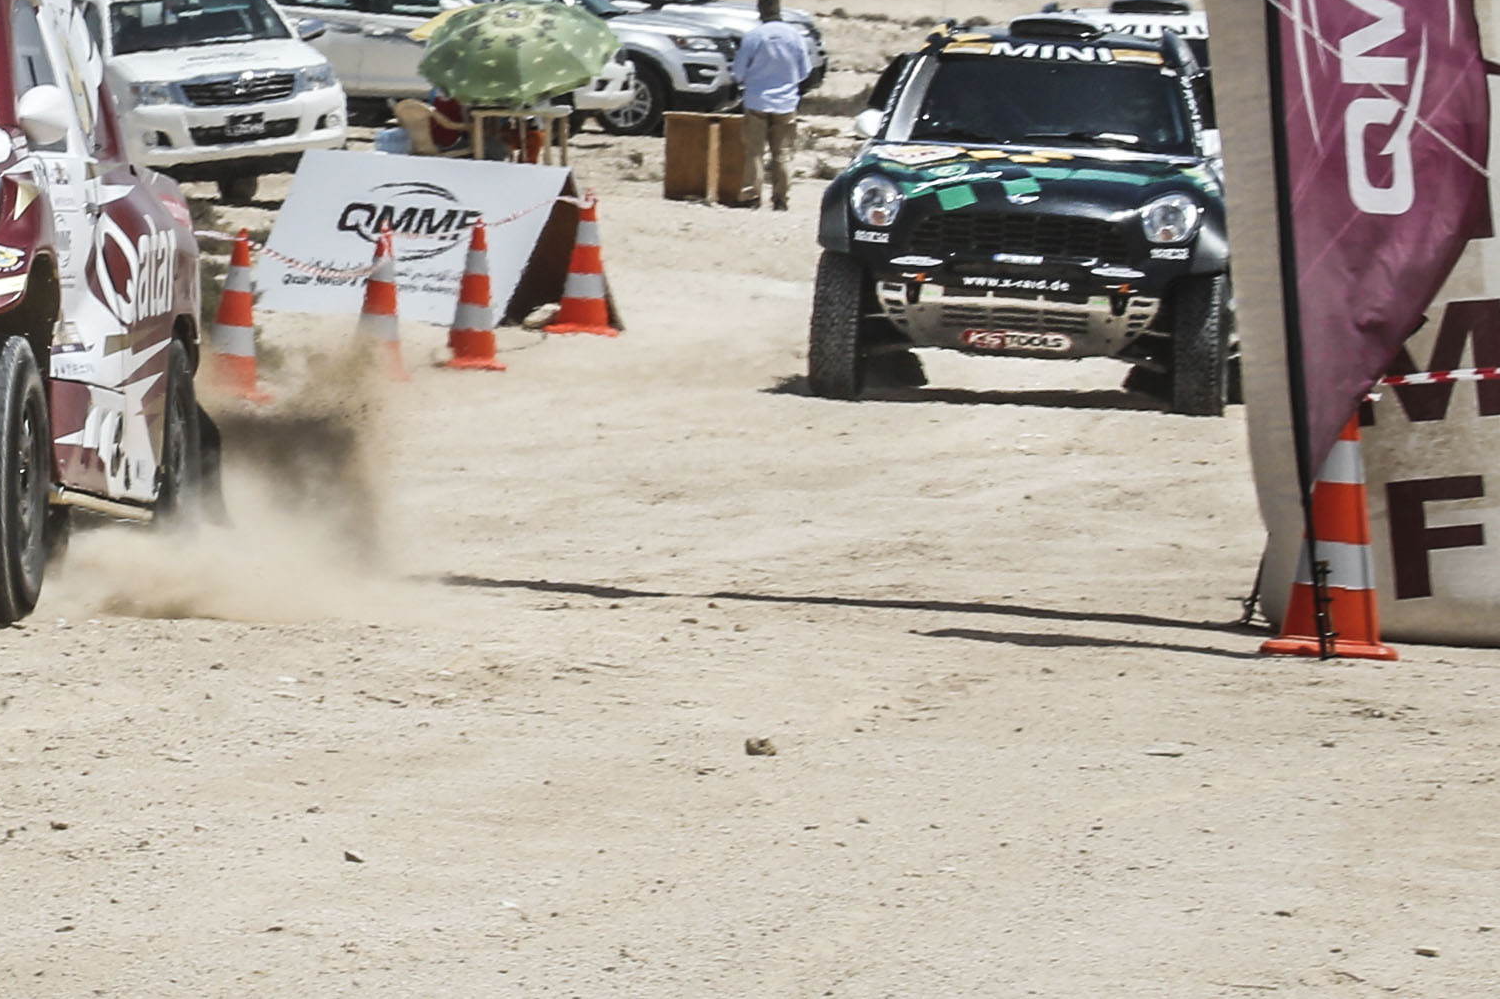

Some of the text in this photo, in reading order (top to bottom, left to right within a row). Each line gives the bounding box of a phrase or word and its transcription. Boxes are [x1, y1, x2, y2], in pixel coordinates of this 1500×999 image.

[990, 42, 1115, 62] MINI
[337, 202, 483, 242] QMMF
[95, 212, 177, 326] Qatar
